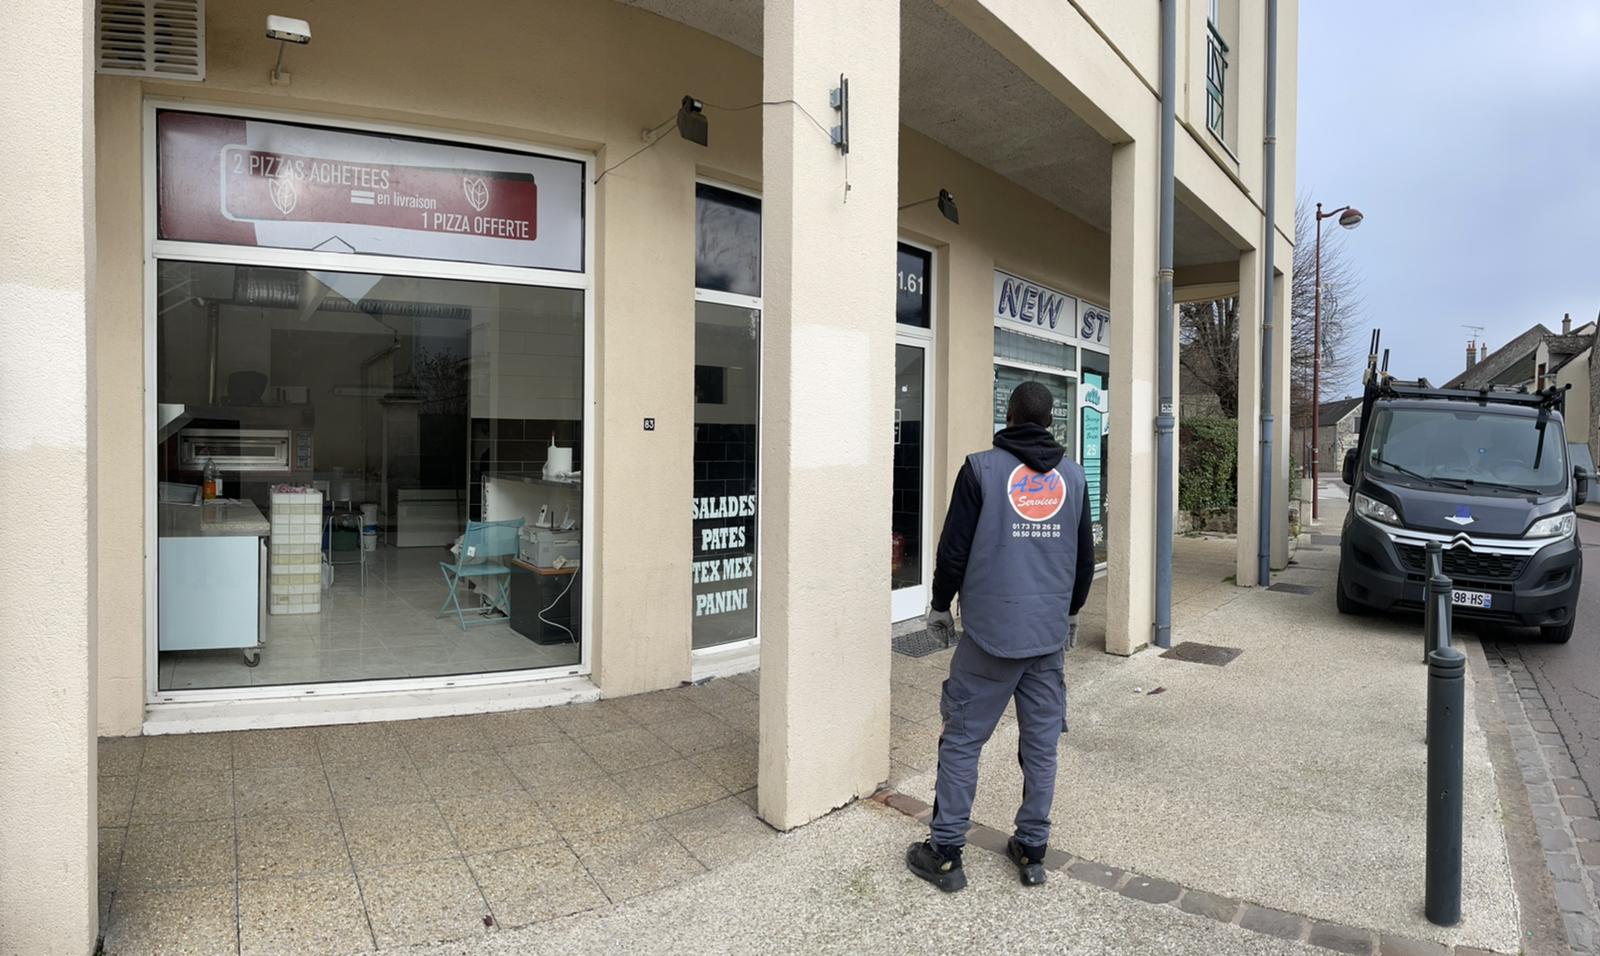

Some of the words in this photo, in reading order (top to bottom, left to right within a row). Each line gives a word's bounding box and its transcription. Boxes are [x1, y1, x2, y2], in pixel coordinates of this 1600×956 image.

[233, 153, 244, 175] 2
[249, 154, 306, 181] PIZZAS
[308, 161, 391, 190] ACHETEES
[377, 193, 391, 205] en
[393, 191, 437, 210] livraison
[421, 211, 429, 229] 1
[433, 212, 471, 233] PIZZA
[473, 216, 530, 239] OFFERTE
[897, 270, 924, 295] 1.61
[997, 277, 1065, 330] NEW
[1080, 307, 1111, 343] ST
[692, 494, 756, 520] SALADES
[1017, 495, 1058, 507] Services
[701, 526, 746, 551] PATES
[692, 559, 721, 584] TEX
[722, 556, 753, 581] MEX
[695, 588, 749, 617] PANINI
